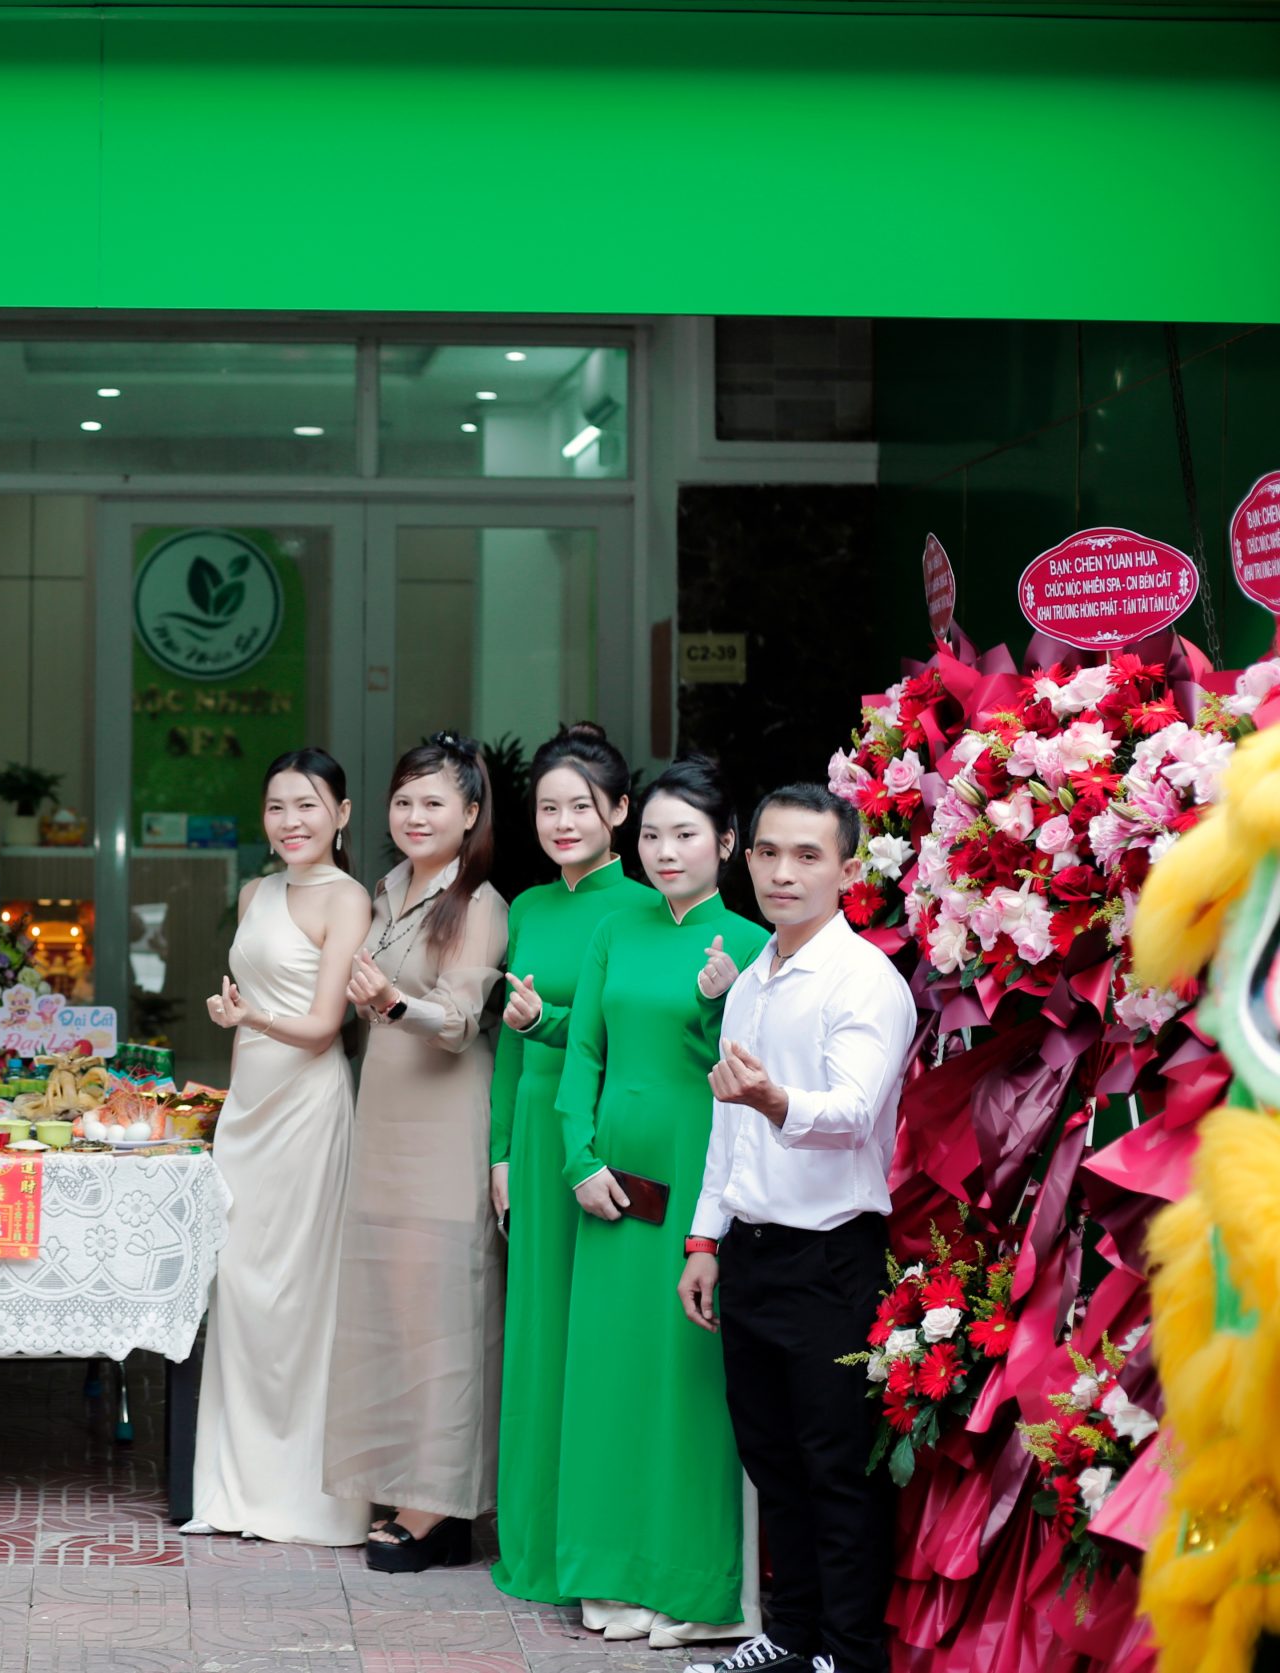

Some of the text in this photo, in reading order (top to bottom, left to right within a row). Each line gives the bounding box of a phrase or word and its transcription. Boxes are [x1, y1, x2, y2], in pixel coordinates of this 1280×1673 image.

[1049, 549, 1159, 578] BẠN: CHEN YUAN HUA
[1044, 579, 1065, 598] CHÚC
[1065, 578, 1082, 599] MỘC
[1082, 575, 1106, 595] NHIÊN
[1106, 577, 1121, 592] SPA
[1126, 575, 1138, 591] CN
[1139, 571, 1155, 590] BẾN
[1156, 569, 1172, 588] CÁT
[1037, 605, 1052, 621] KHAI
[1100, 597, 1118, 617] PHÁT
[1137, 594, 1149, 613] TÀI
[1165, 591, 1180, 614] LỘC
[687, 644, 737, 661] C2-39
